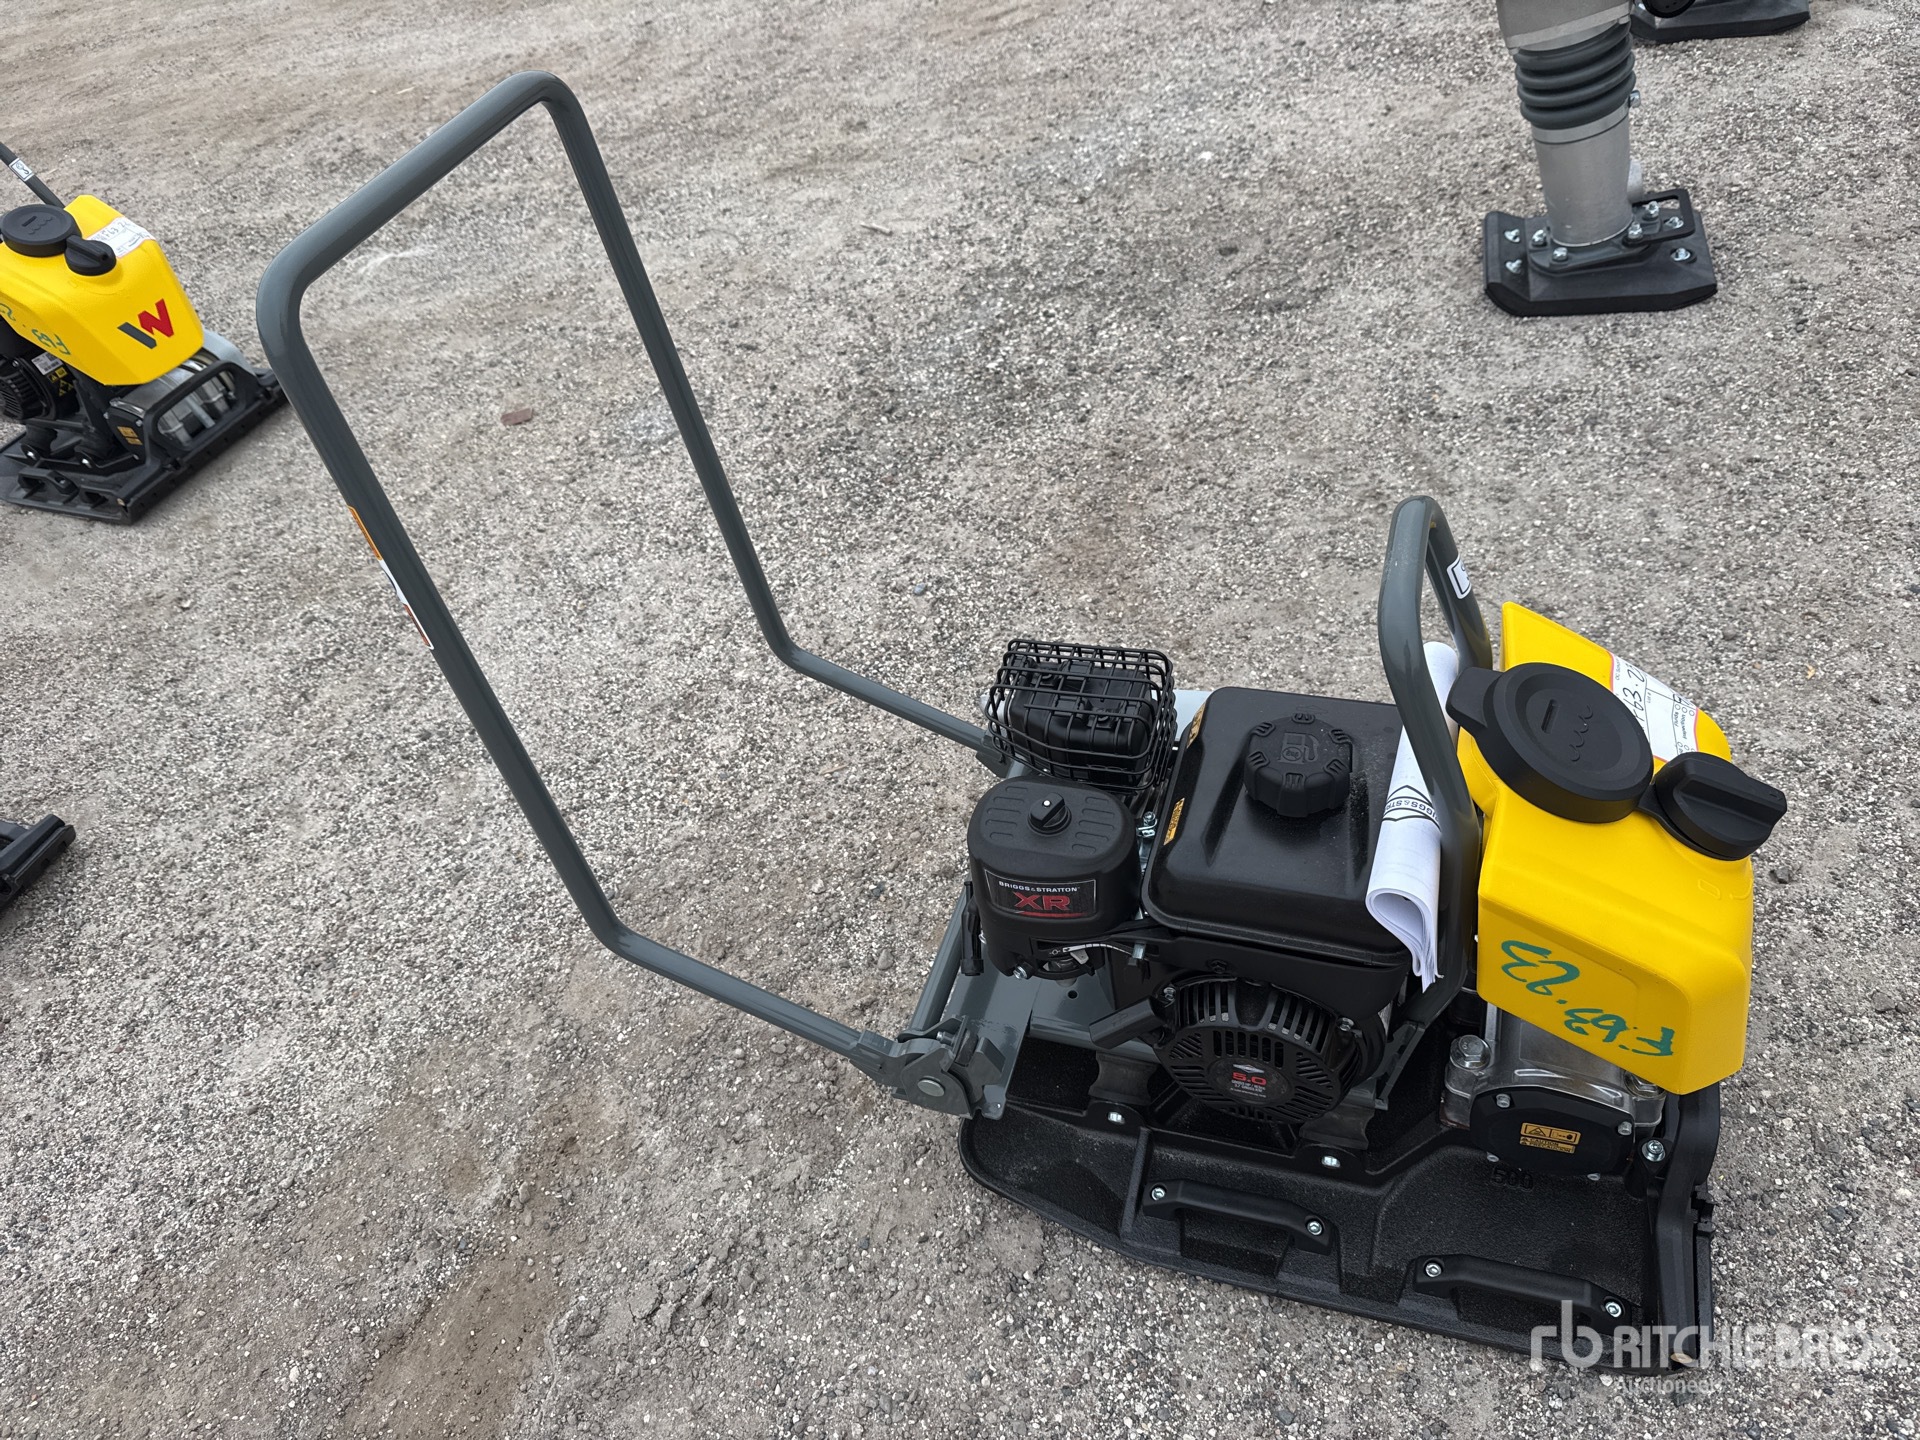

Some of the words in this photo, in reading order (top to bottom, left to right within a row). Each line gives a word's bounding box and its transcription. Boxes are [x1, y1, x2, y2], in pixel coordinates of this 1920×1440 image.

[117, 298, 174, 349] W
[998, 880, 1077, 893] BRIGGS&STRATTON
[1013, 891, 1071, 911] XR
[1232, 1071, 1267, 1086] 5.0
